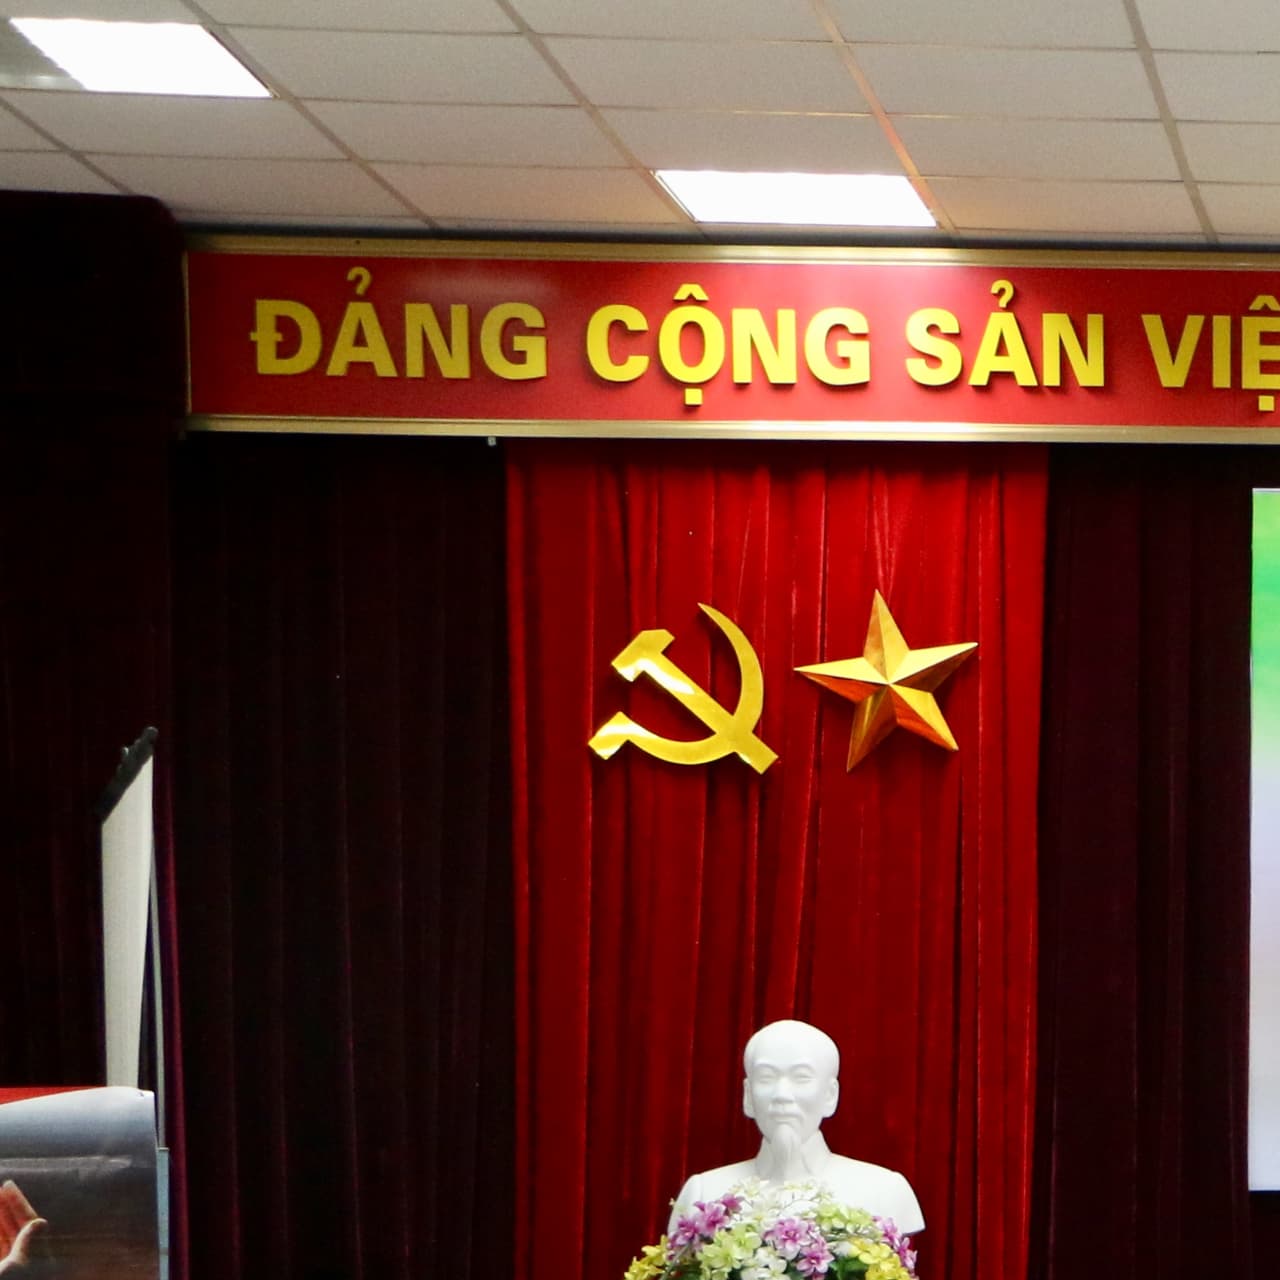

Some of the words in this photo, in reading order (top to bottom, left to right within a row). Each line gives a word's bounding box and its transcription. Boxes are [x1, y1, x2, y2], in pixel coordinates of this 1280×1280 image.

[250, 266, 547, 380] ĐẢNG
[586, 284, 871, 406] CỘNG
[904, 278, 1107, 389] SẢN
